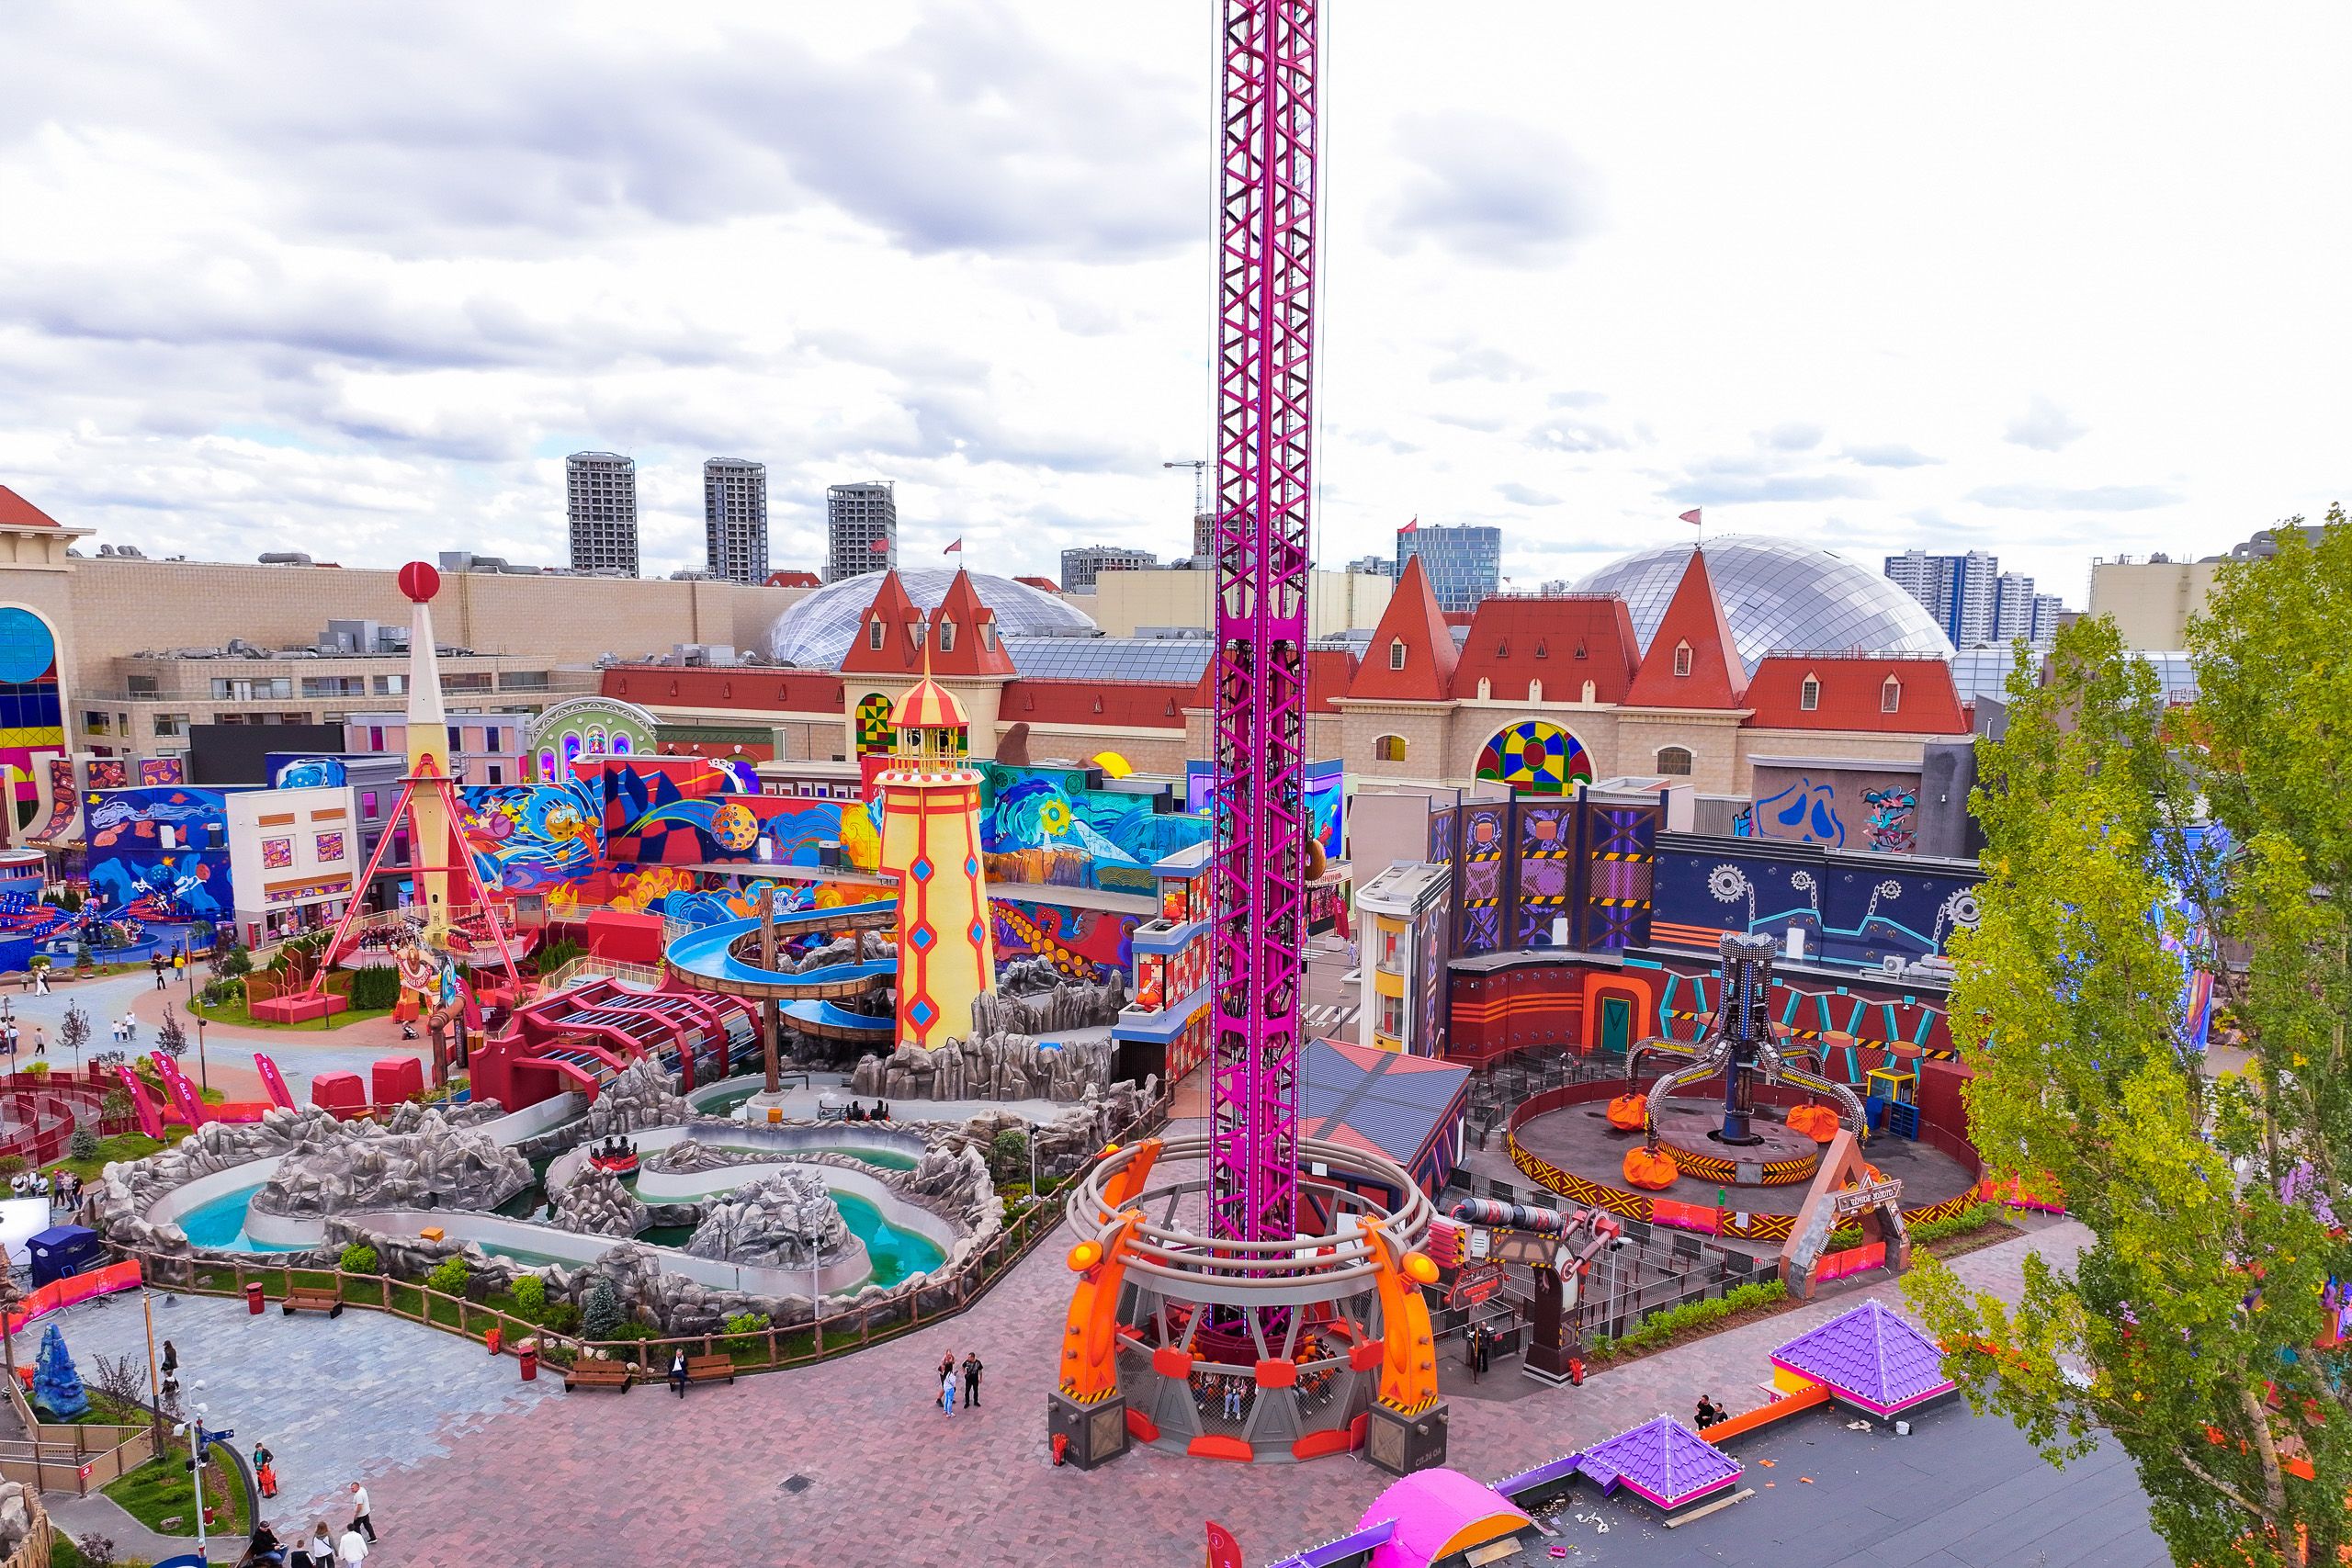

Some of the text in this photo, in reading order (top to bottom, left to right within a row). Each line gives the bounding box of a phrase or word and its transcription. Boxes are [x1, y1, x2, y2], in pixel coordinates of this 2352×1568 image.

[1186, 1001, 1211, 1029] МОЗАИК
[1782, 1073, 1830, 1091] WARNING MOVING PARTS
[1872, 1189, 1893, 1200] ЗОЛОТО
